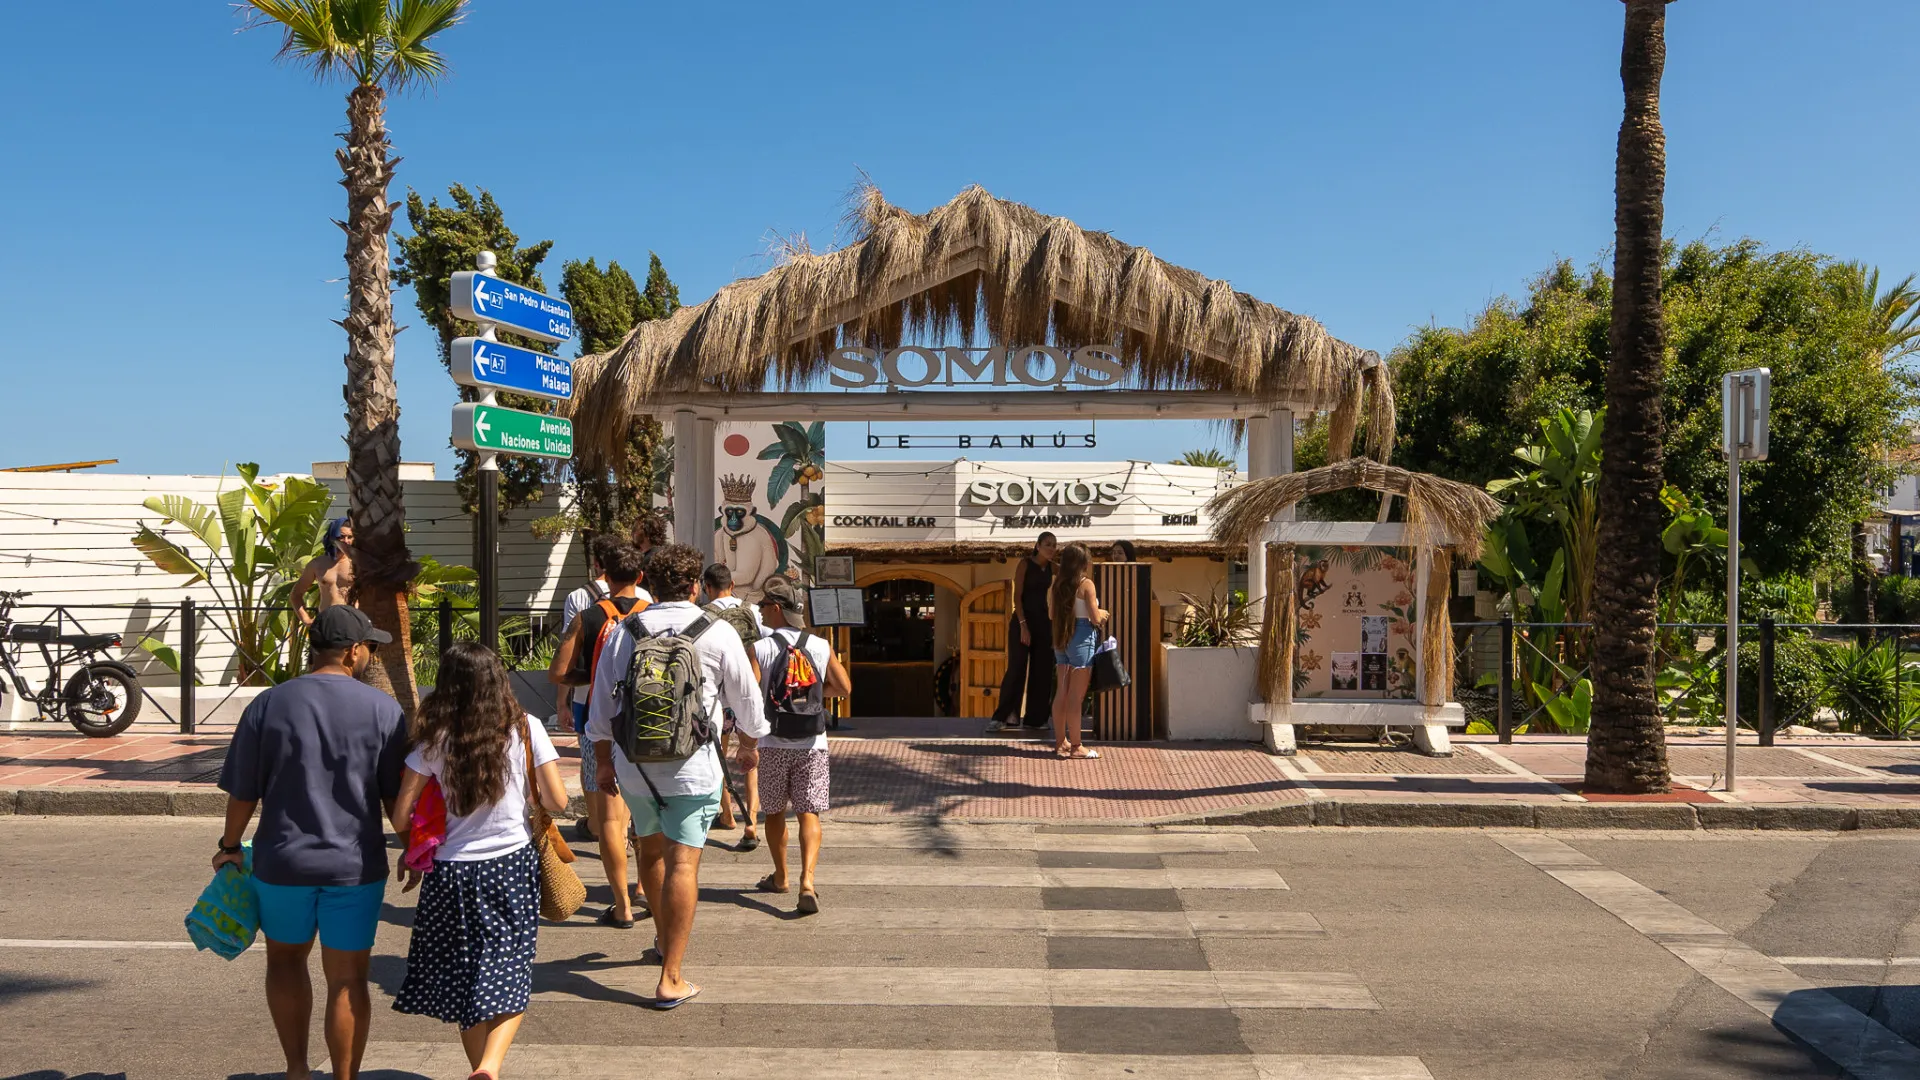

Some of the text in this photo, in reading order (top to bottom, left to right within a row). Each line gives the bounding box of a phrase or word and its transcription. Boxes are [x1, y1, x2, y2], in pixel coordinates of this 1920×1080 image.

[491, 294, 502, 306] A-7
[504, 288, 570, 318] San Pedro Alcántara
[549, 319, 570, 337] Cádiz
[492, 356, 505, 371] A-7
[536, 356, 570, 376] Marbella
[829, 345, 1125, 388] SOMOS
[542, 374, 570, 393] Málaga
[540, 420, 570, 436] Avenida
[501, 432, 570, 454] Naciones Unidas
[867, 430, 1096, 449] DE BANÚS
[969, 480, 1123, 506] SOMOS
[833, 516, 936, 528] COCKTAIL BAR
[1003, 515, 1092, 528] RESTAURANTE
